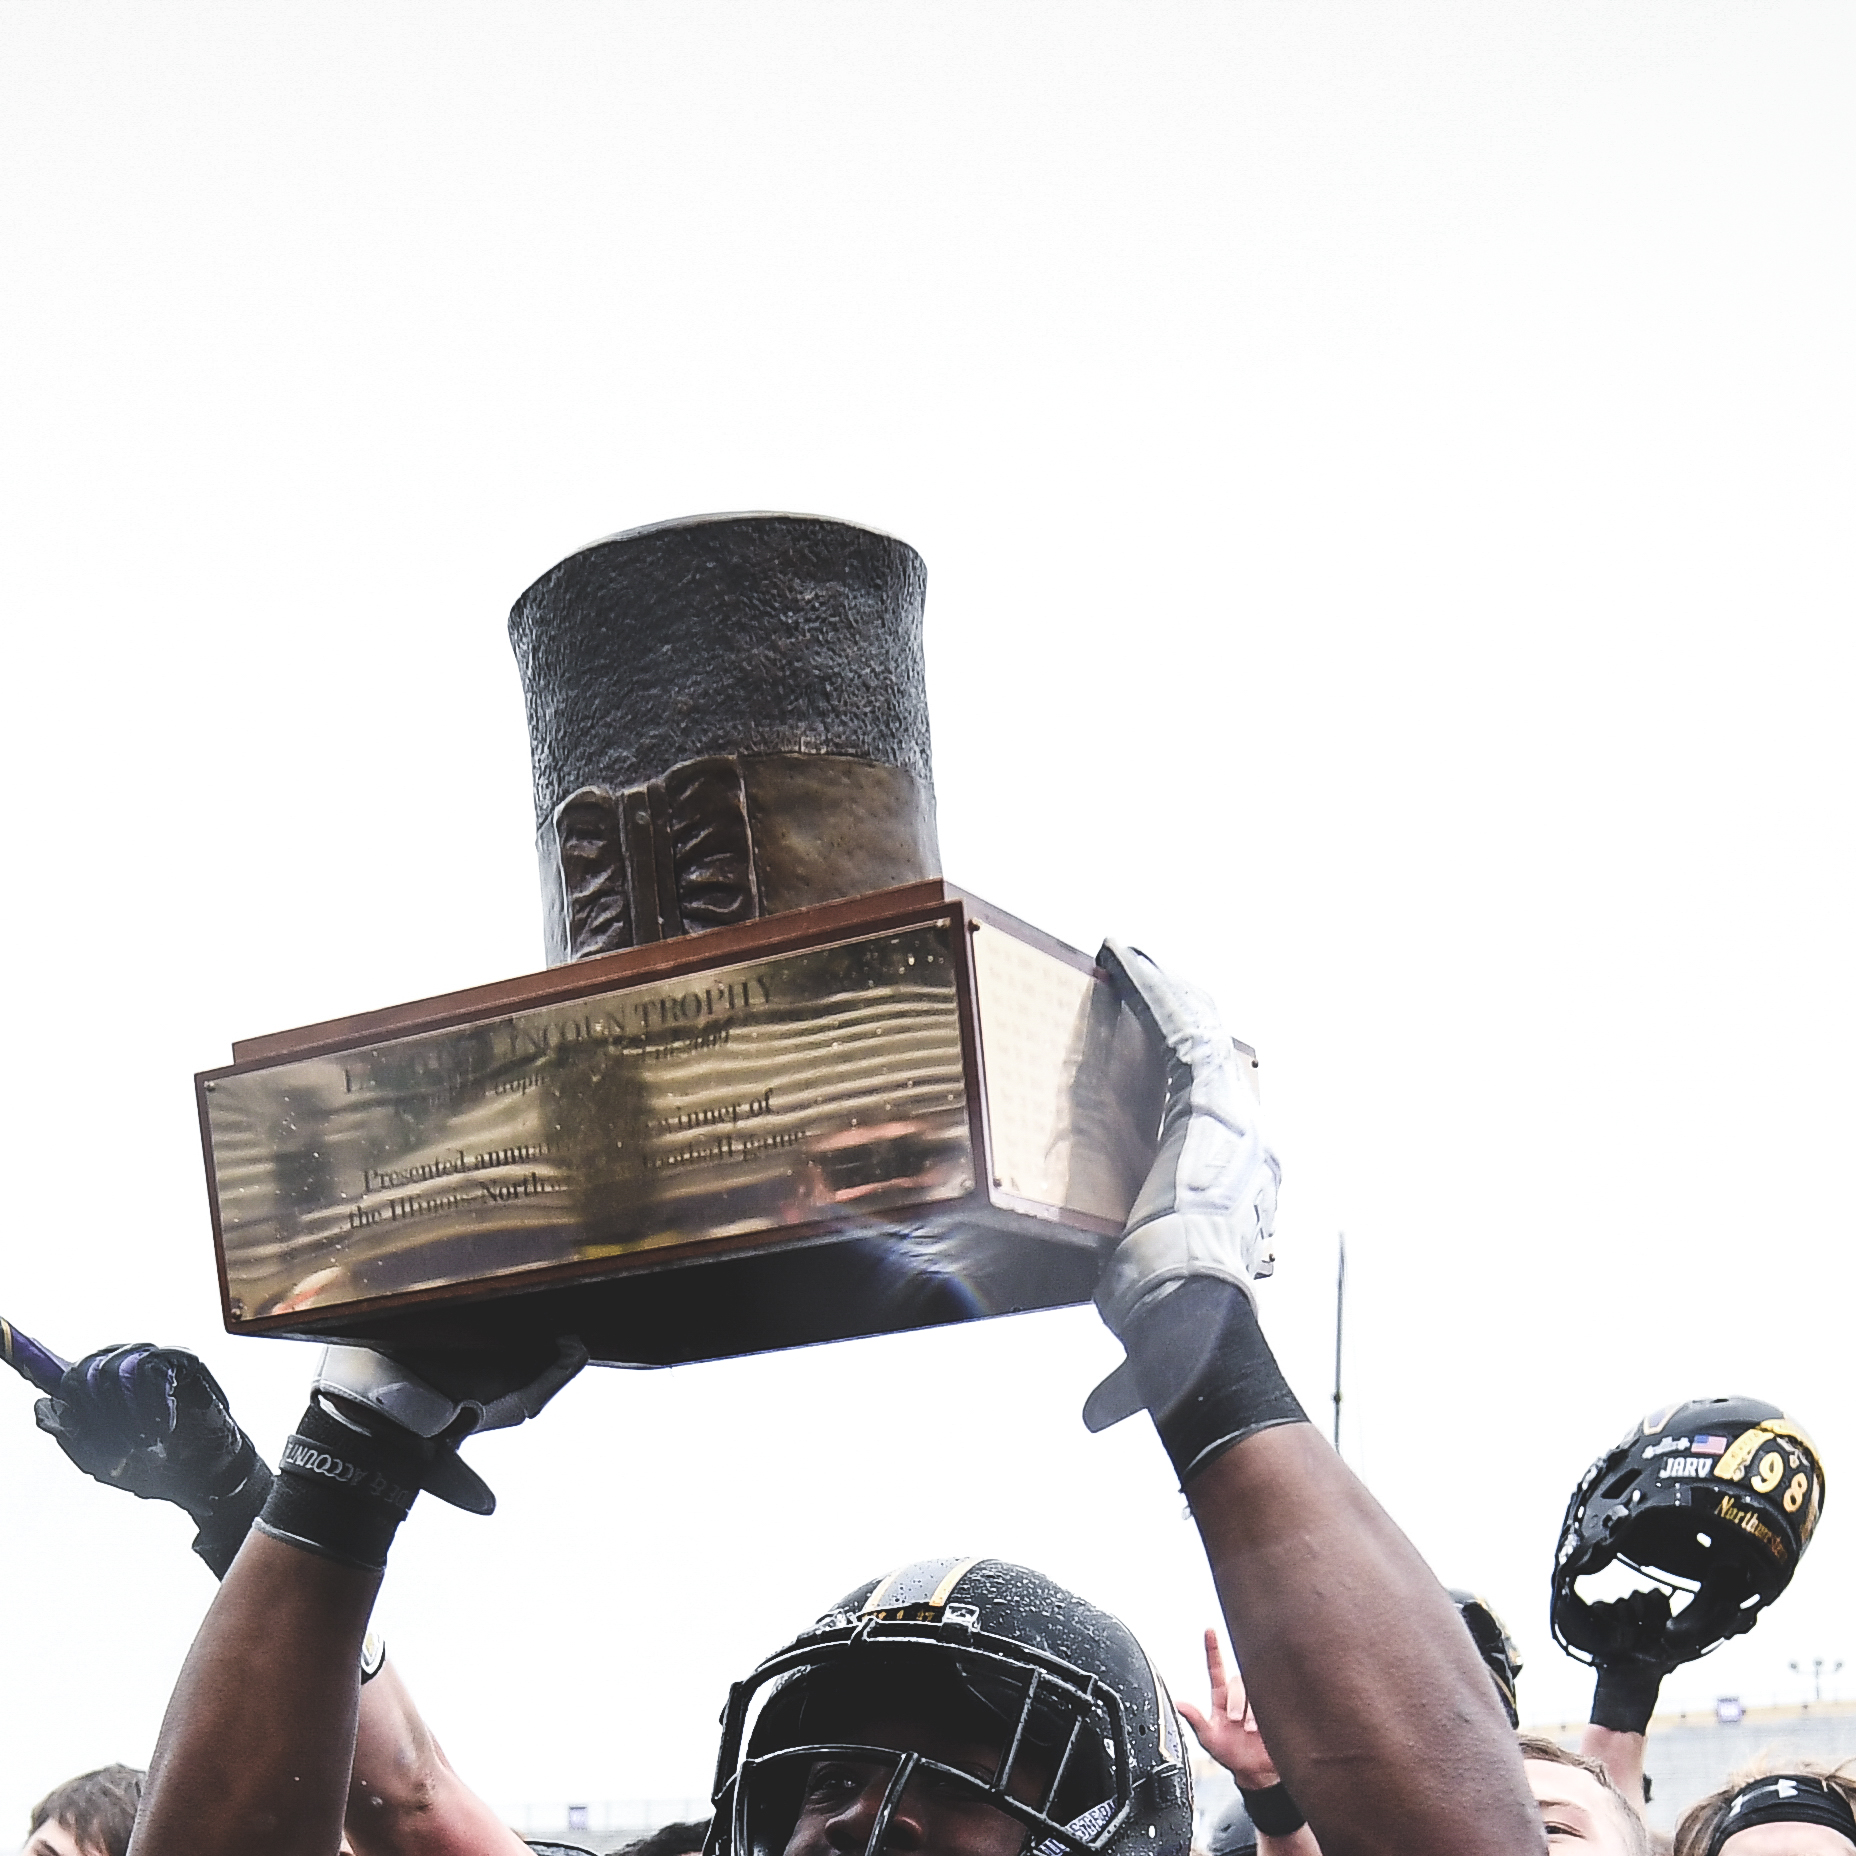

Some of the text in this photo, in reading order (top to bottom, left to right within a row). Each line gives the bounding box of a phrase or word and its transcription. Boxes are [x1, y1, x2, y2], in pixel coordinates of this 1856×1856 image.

[634, 974, 776, 1030] TROPHY
[363, 1150, 466, 1193] Presented
[749, 1087, 775, 1114] of
[348, 1205, 382, 1229] the
[1659, 1457, 1713, 1478] JARV
[1750, 1451, 1808, 1513] 98
